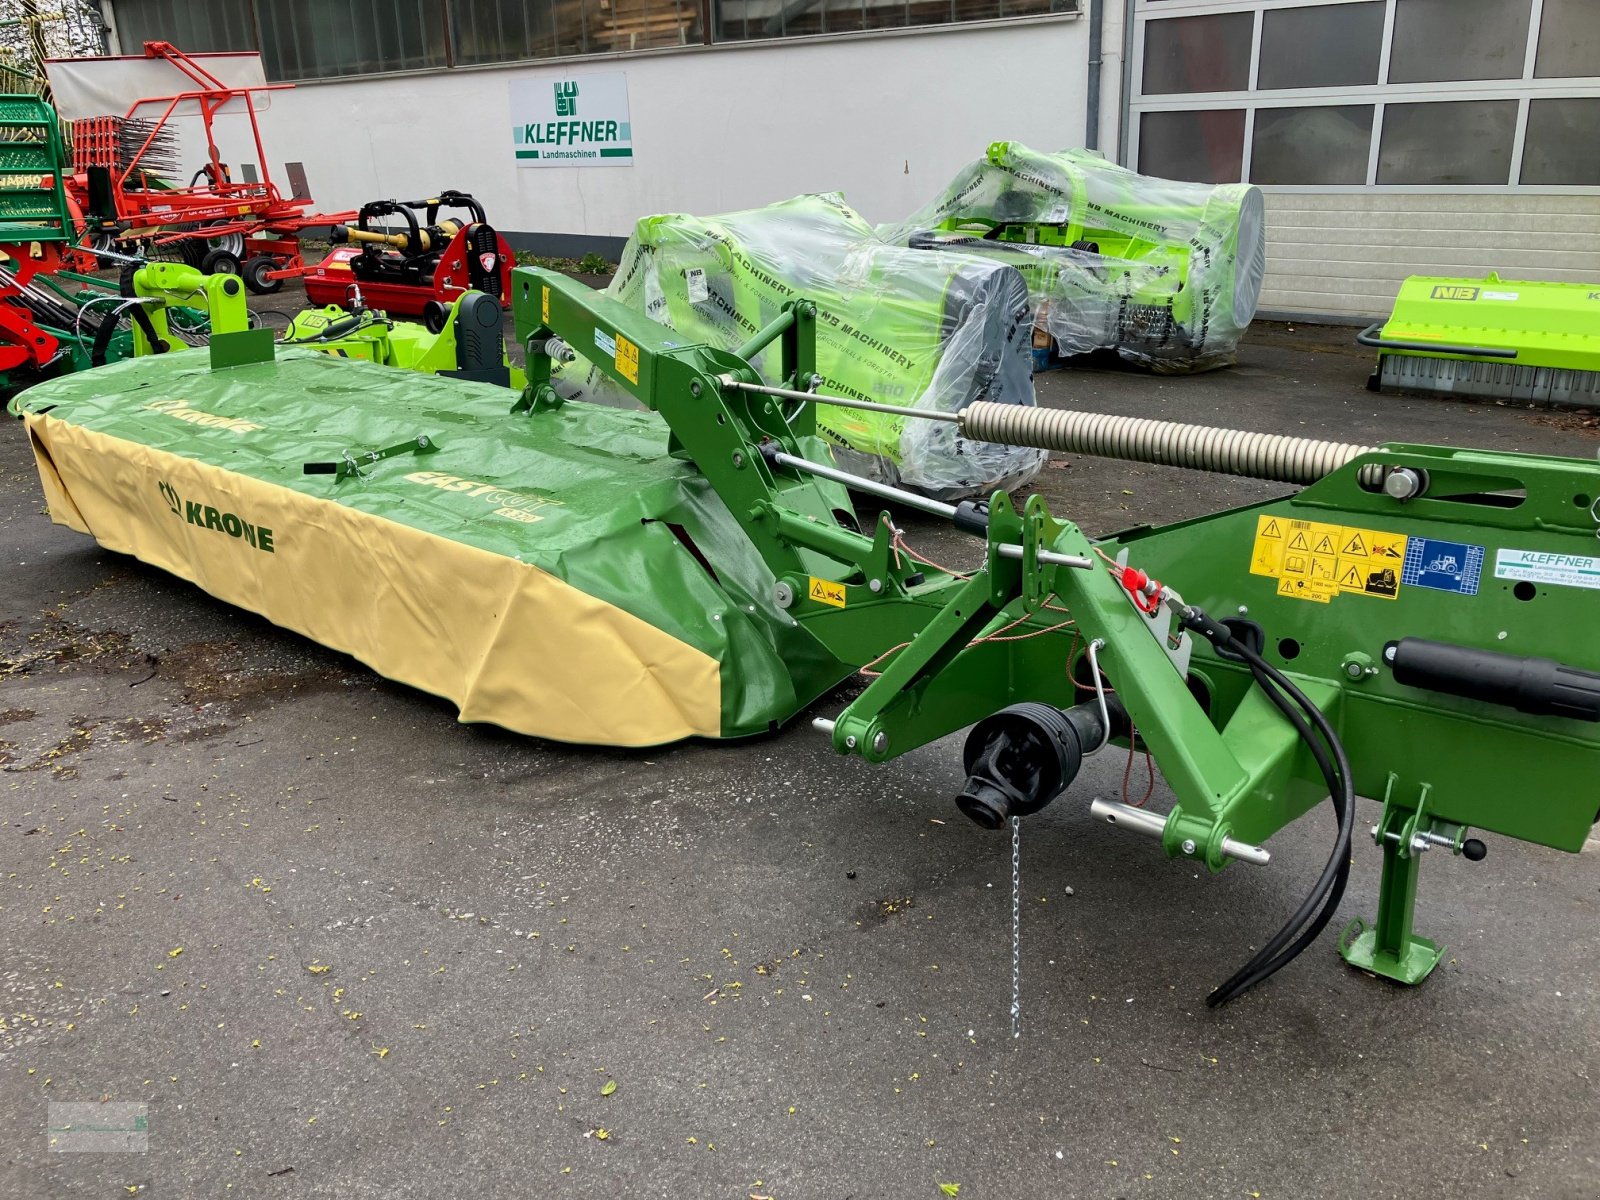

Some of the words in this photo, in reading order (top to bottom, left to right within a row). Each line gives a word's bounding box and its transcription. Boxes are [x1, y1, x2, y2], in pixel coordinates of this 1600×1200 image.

[525, 120, 618, 145] KLEFFNER
[542, 150, 597, 159] Landmaschinen
[1087, 202, 1102, 211] NB
[1104, 209, 1168, 233] MACHINERY
[690, 269, 703, 277] NB
[821, 311, 840, 327] NB
[841, 323, 915, 370] MACHINERY
[820, 375, 877, 403] ACHINER
[186, 500, 275, 553] KRONE
[1521, 552, 1593, 568] KLEFFNER
